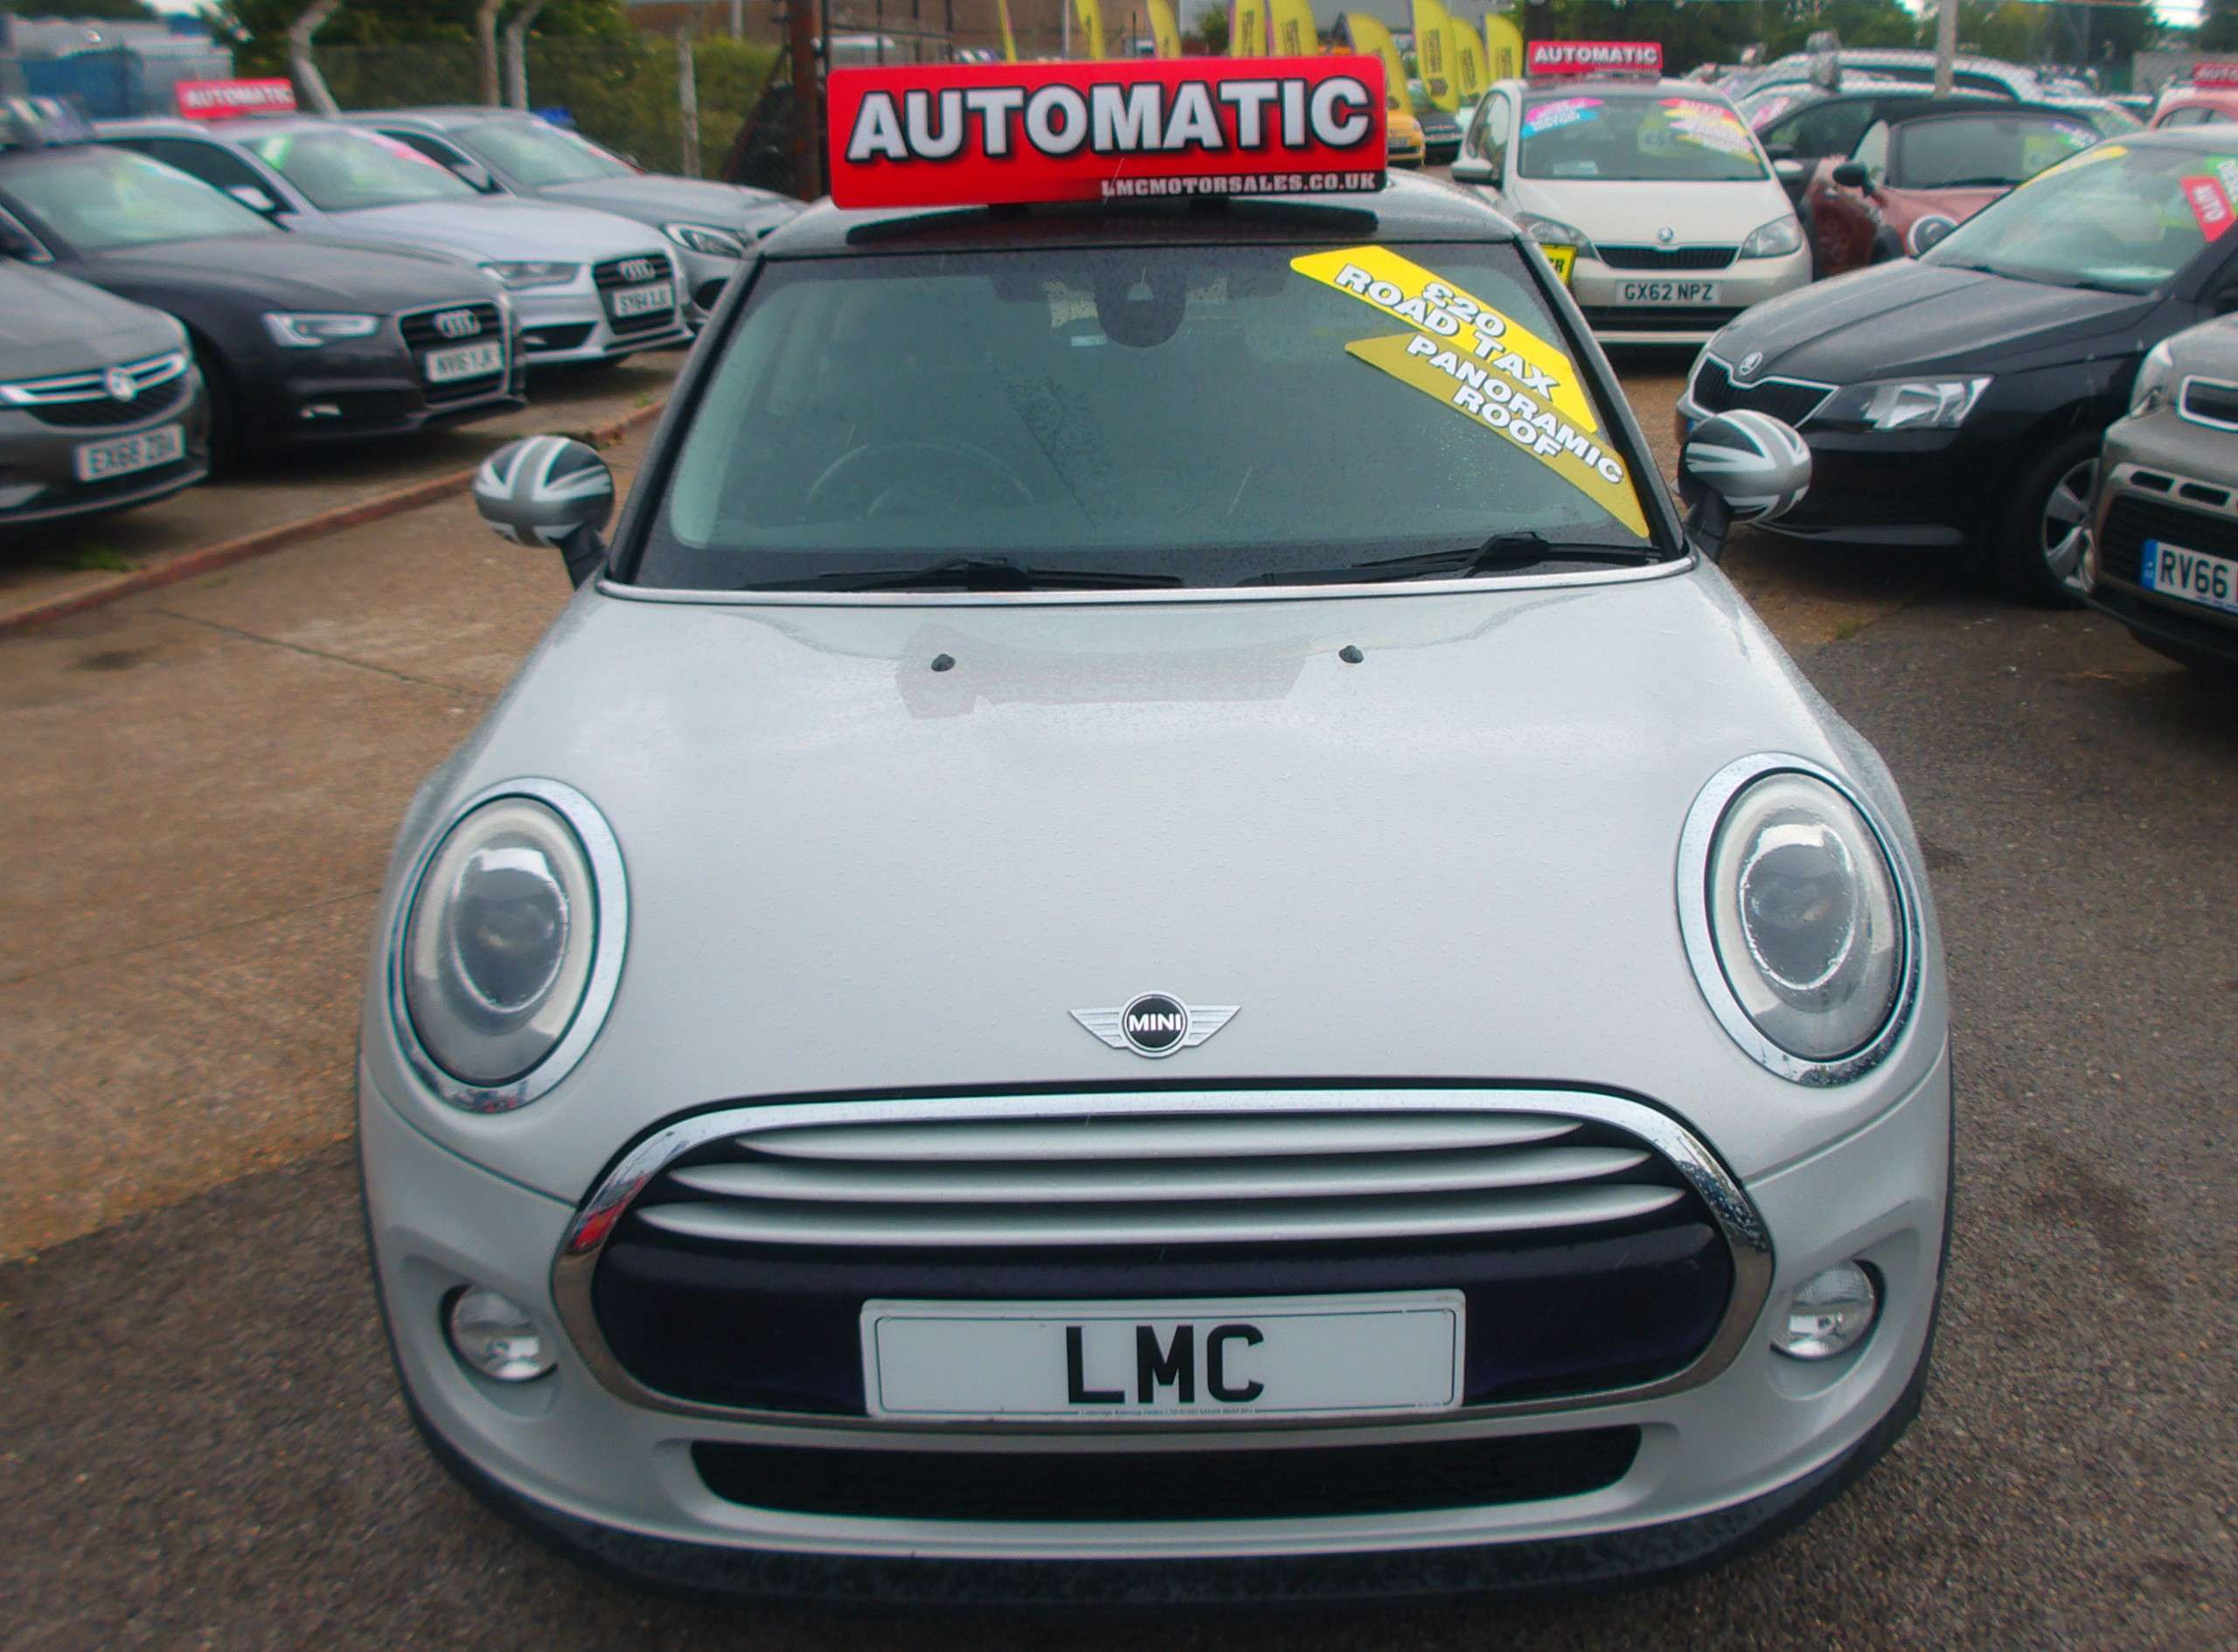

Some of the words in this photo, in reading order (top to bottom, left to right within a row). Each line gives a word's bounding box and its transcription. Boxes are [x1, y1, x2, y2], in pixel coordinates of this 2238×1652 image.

[1534, 45, 1658, 65] AUTOMATIC
[186, 85, 294, 108] AUTOMATIC
[846, 76, 1371, 161] AUTOMATIC
[1101, 172, 1377, 197] LMCMOTORSALES.CO.UK
[1421, 281, 1506, 338] £20
[1624, 283, 1672, 301] GX62
[1678, 283, 1713, 301] NPZ
[1334, 263, 1460, 338] ROAD
[1472, 331, 1561, 402] TAX
[1406, 334, 1625, 484] PANORAMIC
[1452, 384, 1564, 459] ROOF
[2159, 549, 2229, 600] RV66
[1128, 1012, 1182, 1032] MINI
[1065, 1324, 1265, 1405] LMC
